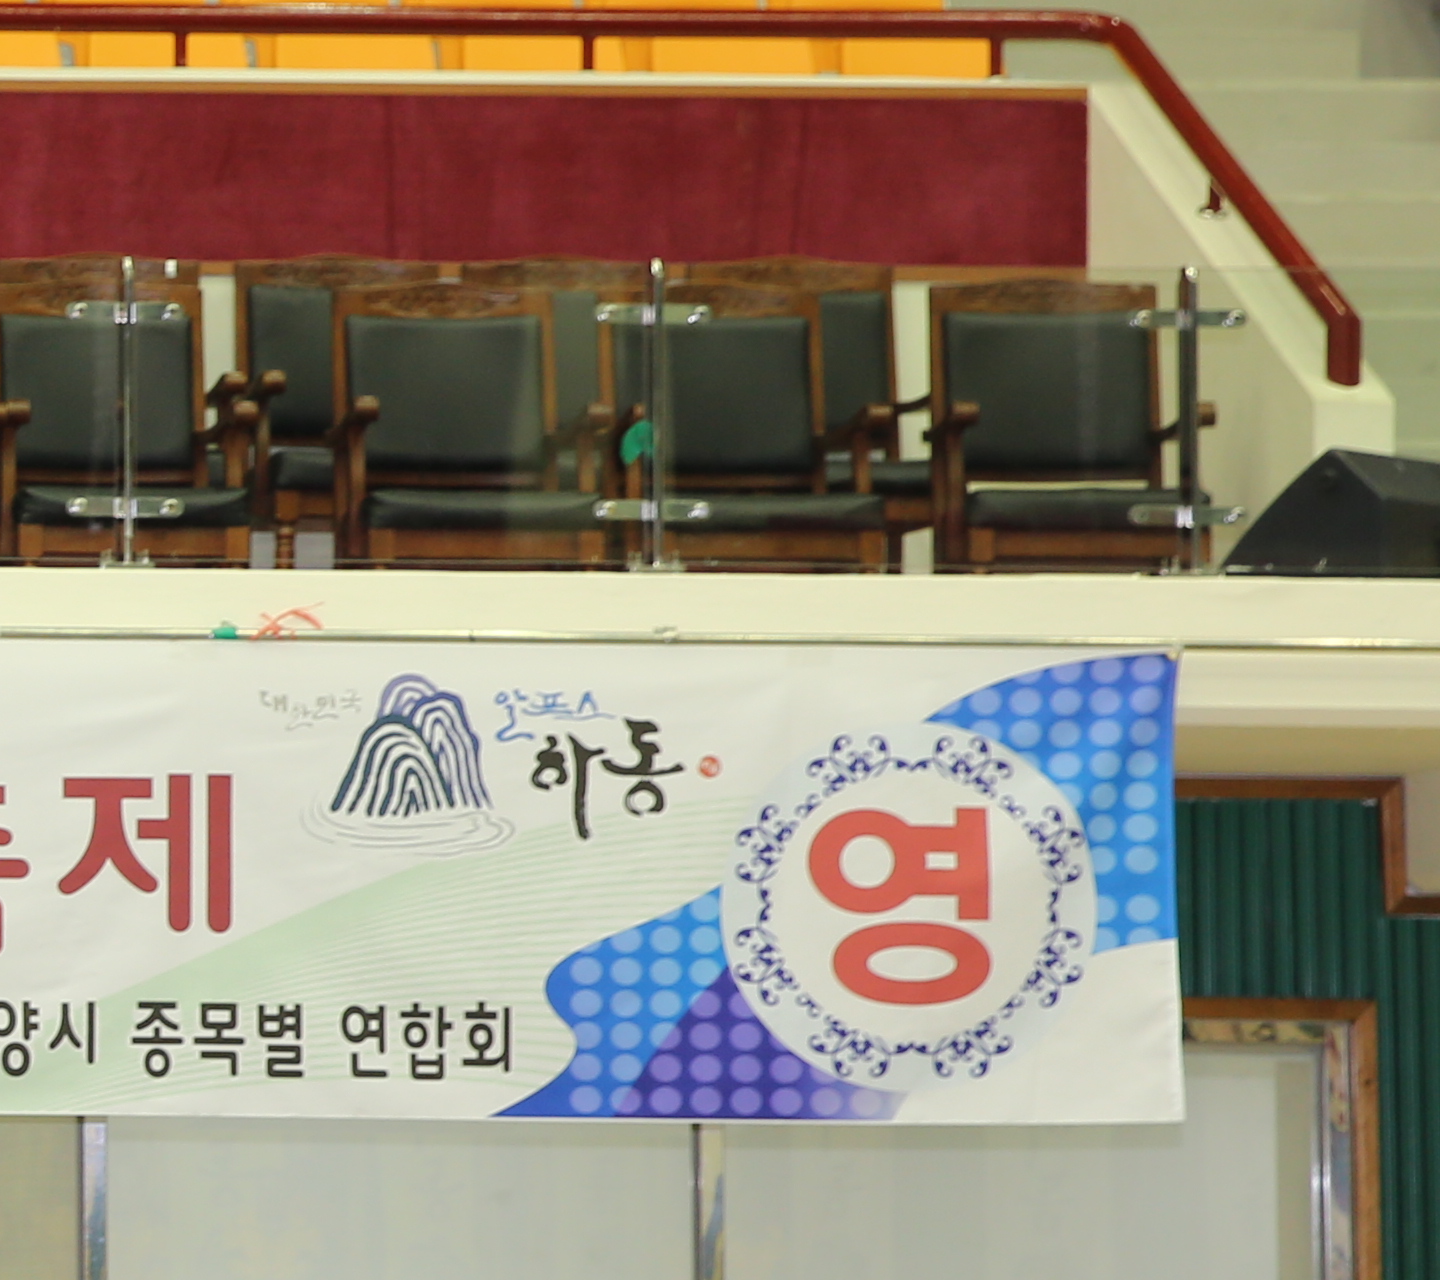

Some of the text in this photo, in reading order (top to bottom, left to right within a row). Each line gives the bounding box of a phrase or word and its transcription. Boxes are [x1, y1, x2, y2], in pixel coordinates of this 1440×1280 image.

[259, 689, 363, 732] 대한민국
[494, 687, 617, 742] 알프스
[531, 717, 684, 840] 하동
[807, 806, 993, 1006] 영
[131, 1001, 304, 1078] 종목별
[340, 1001, 512, 1080] 연합회
